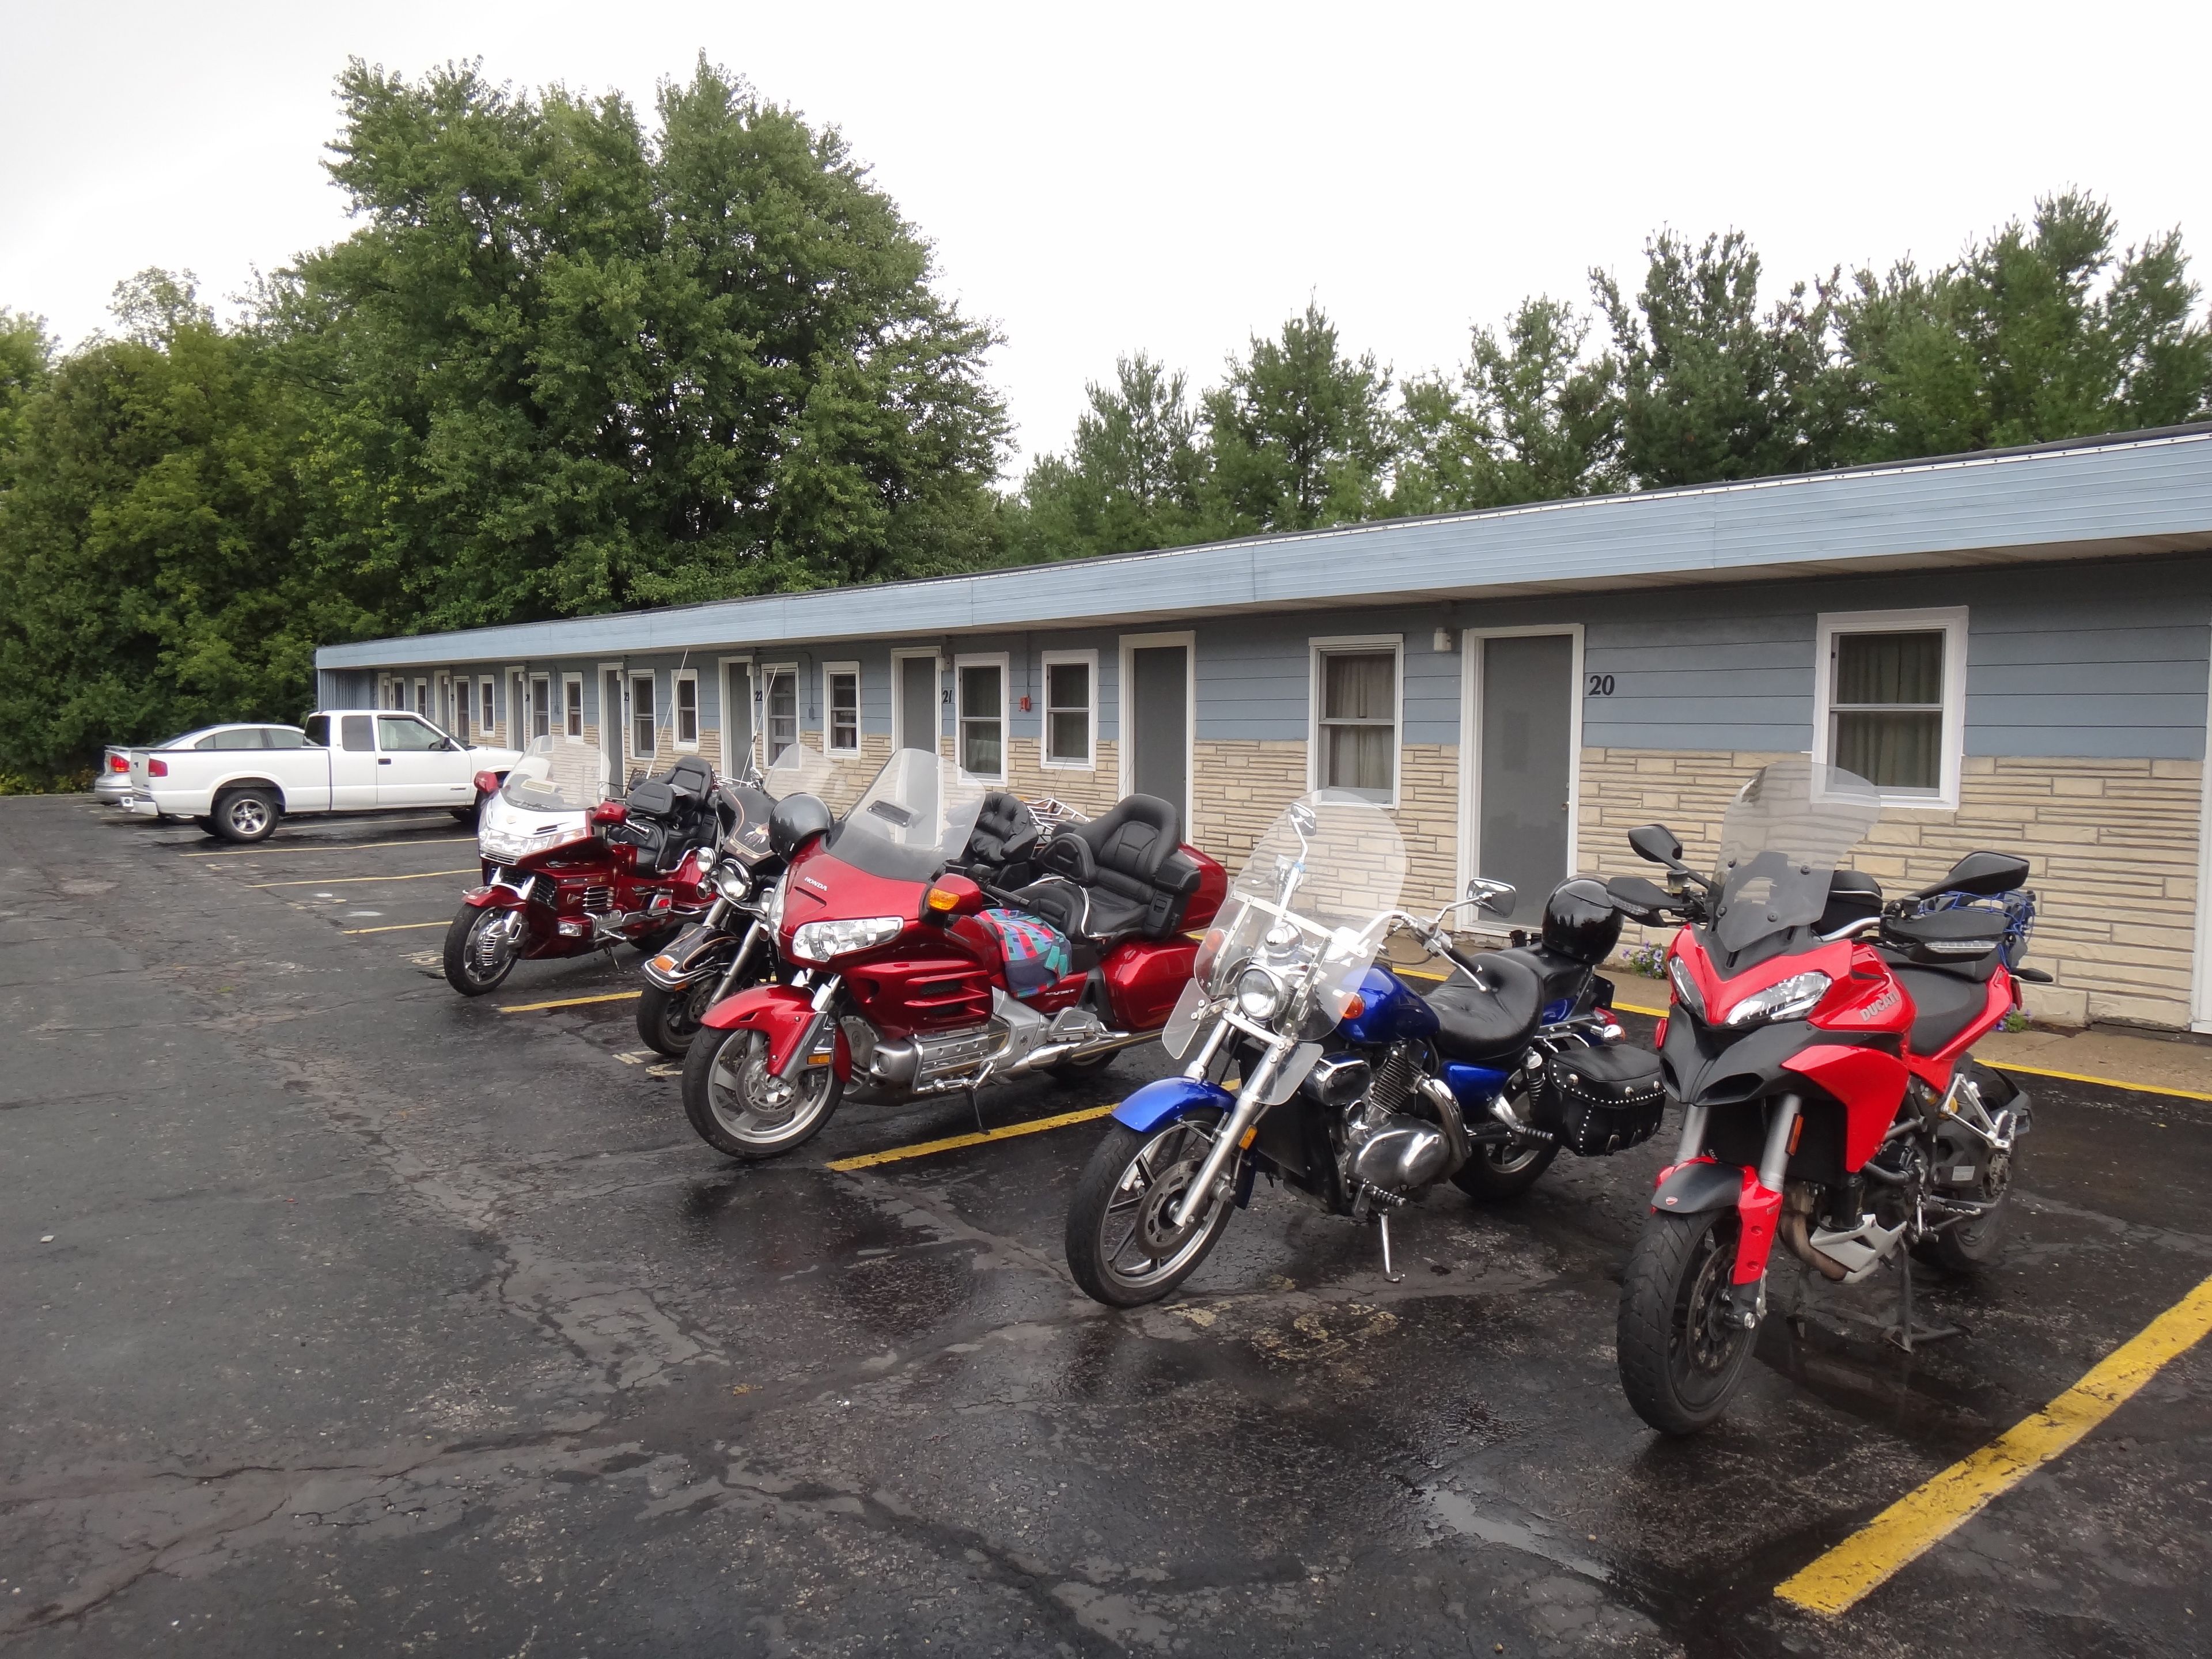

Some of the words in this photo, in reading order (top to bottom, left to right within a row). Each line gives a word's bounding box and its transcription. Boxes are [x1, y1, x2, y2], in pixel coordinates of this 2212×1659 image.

[1588, 675, 1615, 695] 20
[755, 691, 763, 702] 22
[942, 690, 952, 703] 21
[804, 876, 827, 891] HONDA
[1859, 991, 1900, 1021] DUCATI
